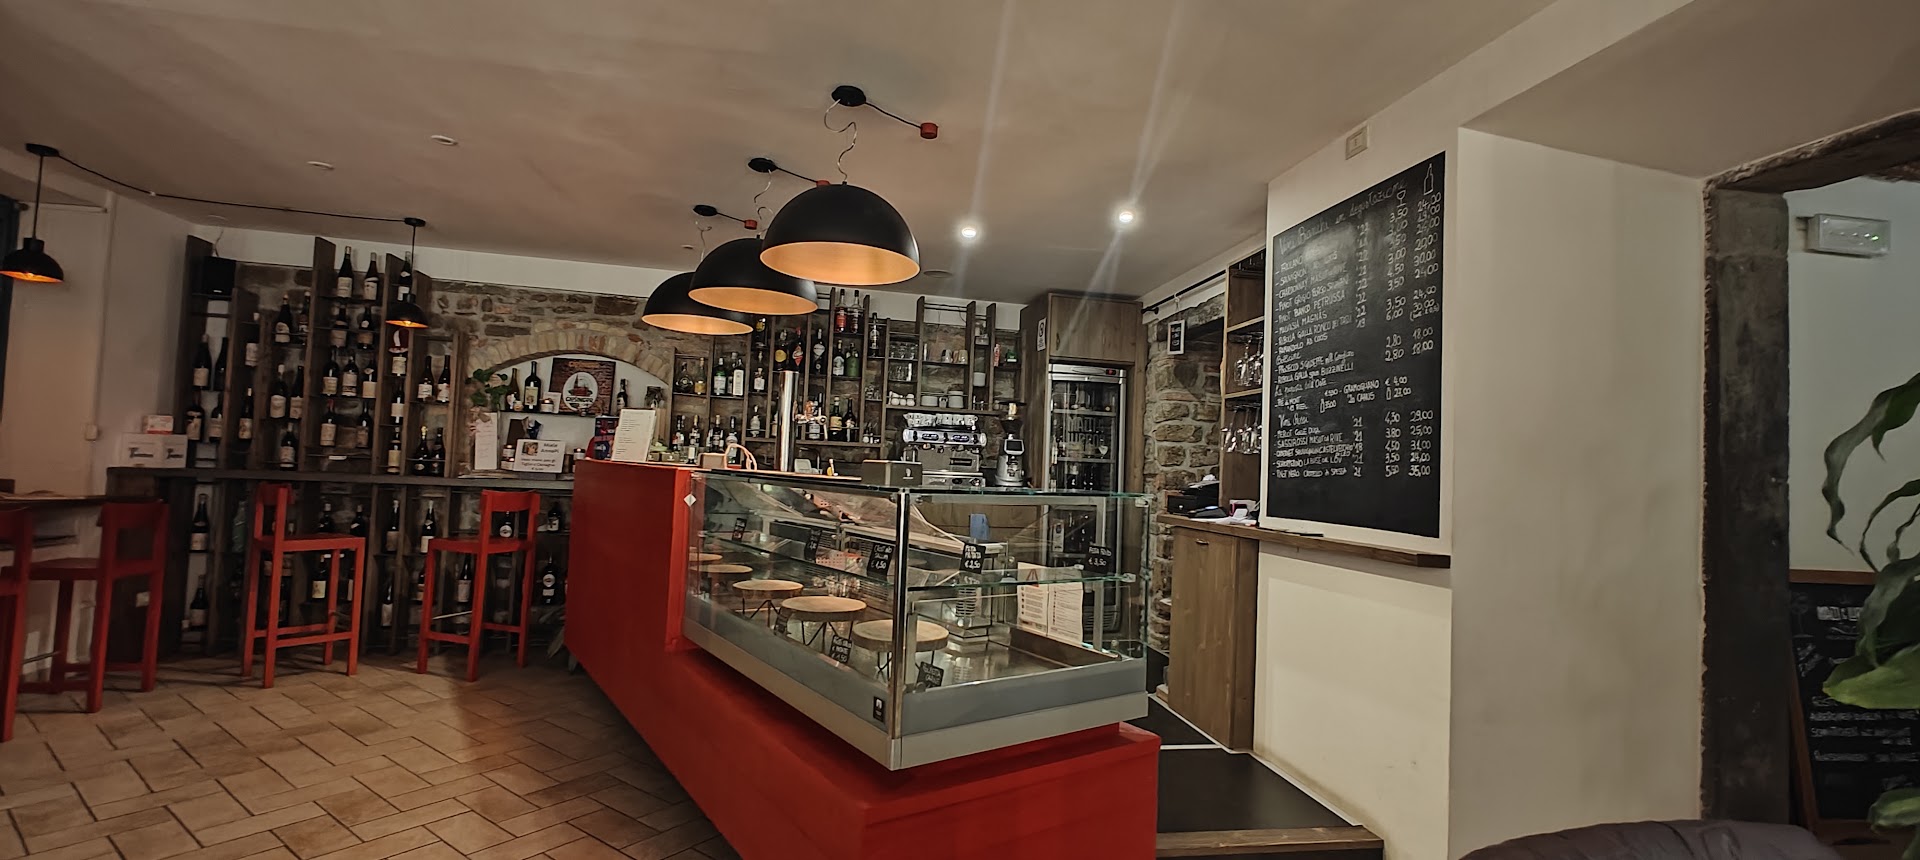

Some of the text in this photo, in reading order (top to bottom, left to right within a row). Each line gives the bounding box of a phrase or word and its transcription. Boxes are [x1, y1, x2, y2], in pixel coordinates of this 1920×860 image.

[1389, 206, 1409, 223] 3,50
[1417, 191, 1442, 213] 24,00
[1387, 275, 1405, 292] 3,50
[1312, 289, 1346, 311] PETRUSSA
[1386, 295, 1407, 312] 3,50
[1413, 285, 1437, 300] 24,00
[1385, 307, 1404, 321] 6,00
[1386, 332, 1402, 348] 2,80
[1384, 348, 1405, 363] 2,80
[1409, 424, 1433, 437] 25,00
[1408, 464, 1432, 478] 35,00
